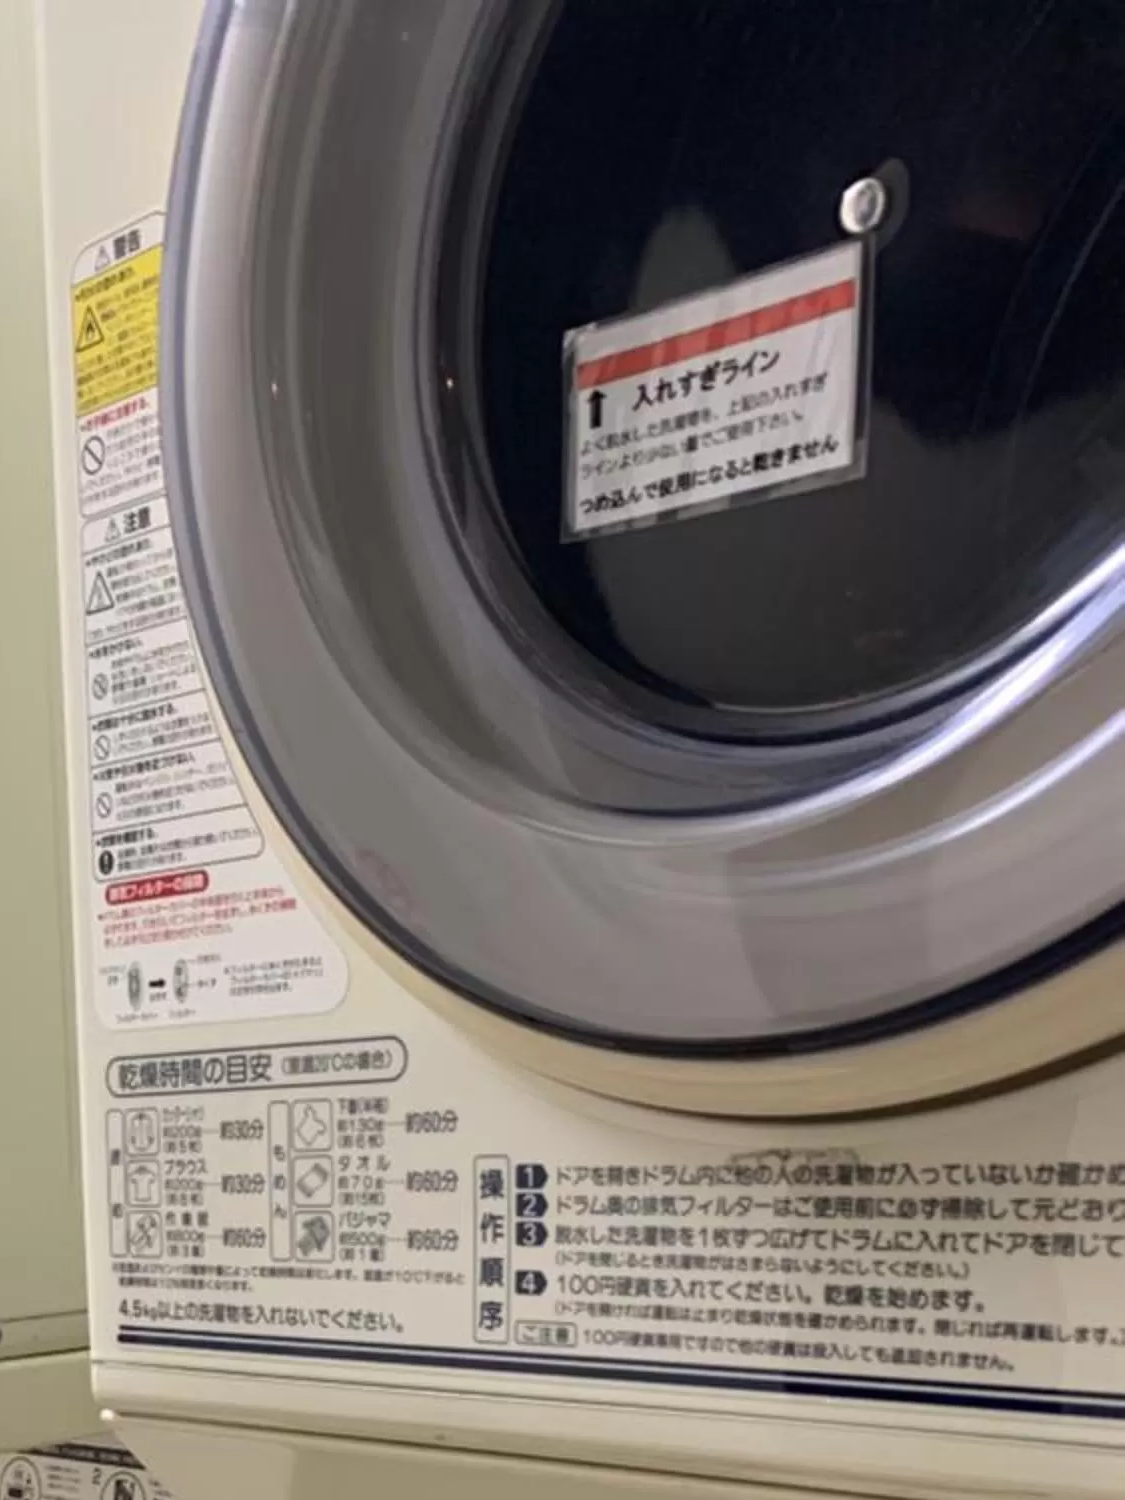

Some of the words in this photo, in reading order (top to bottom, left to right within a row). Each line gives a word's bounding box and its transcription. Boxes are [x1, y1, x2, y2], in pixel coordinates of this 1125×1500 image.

[632, 350, 781, 411] 入れすぎライン
[118, 1054, 272, 1090] 乾燥時間の目安
[478, 1168, 505, 1331] 操作順序
